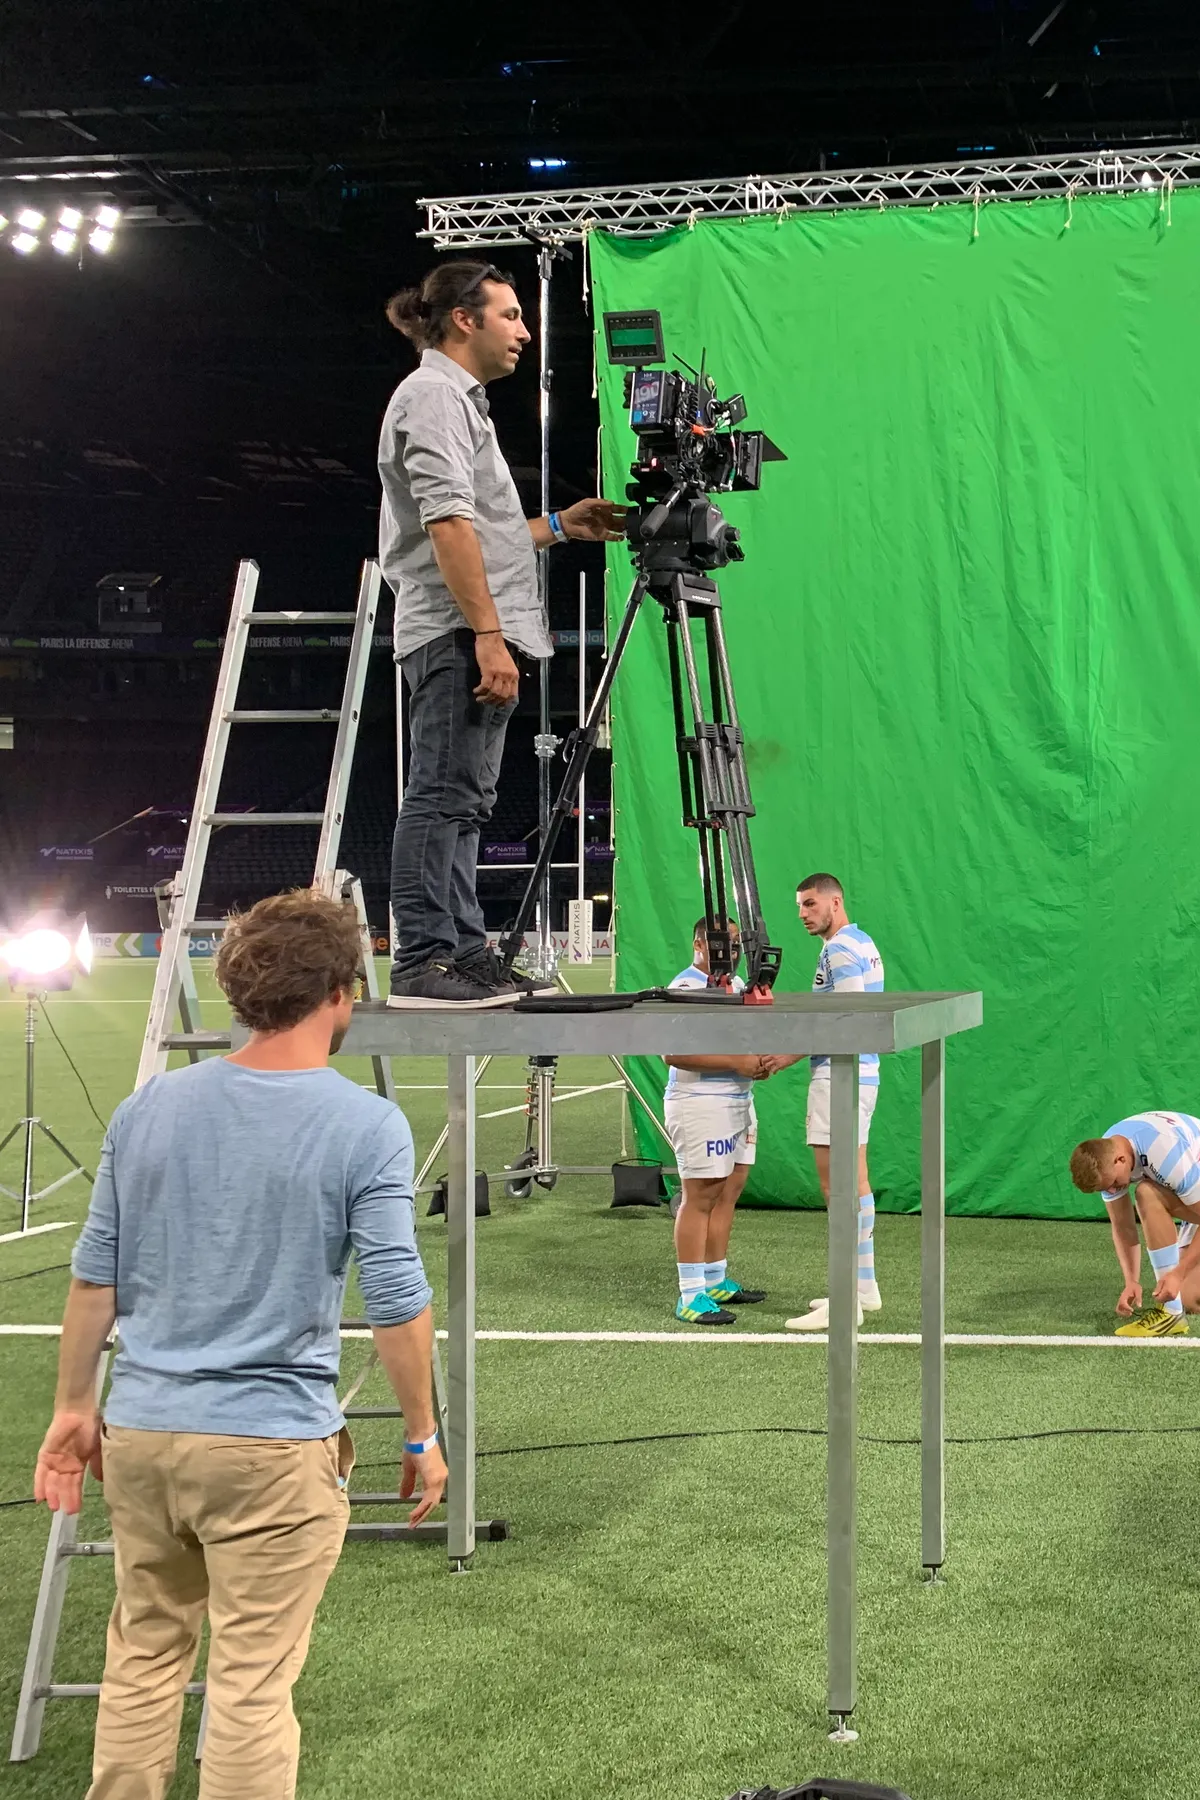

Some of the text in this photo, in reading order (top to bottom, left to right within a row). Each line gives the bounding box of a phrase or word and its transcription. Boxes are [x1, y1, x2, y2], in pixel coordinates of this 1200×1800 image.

[40, 638, 134, 649] PARIS LA DEFENSE ARENA
[371, 636, 392, 646] FENSE
